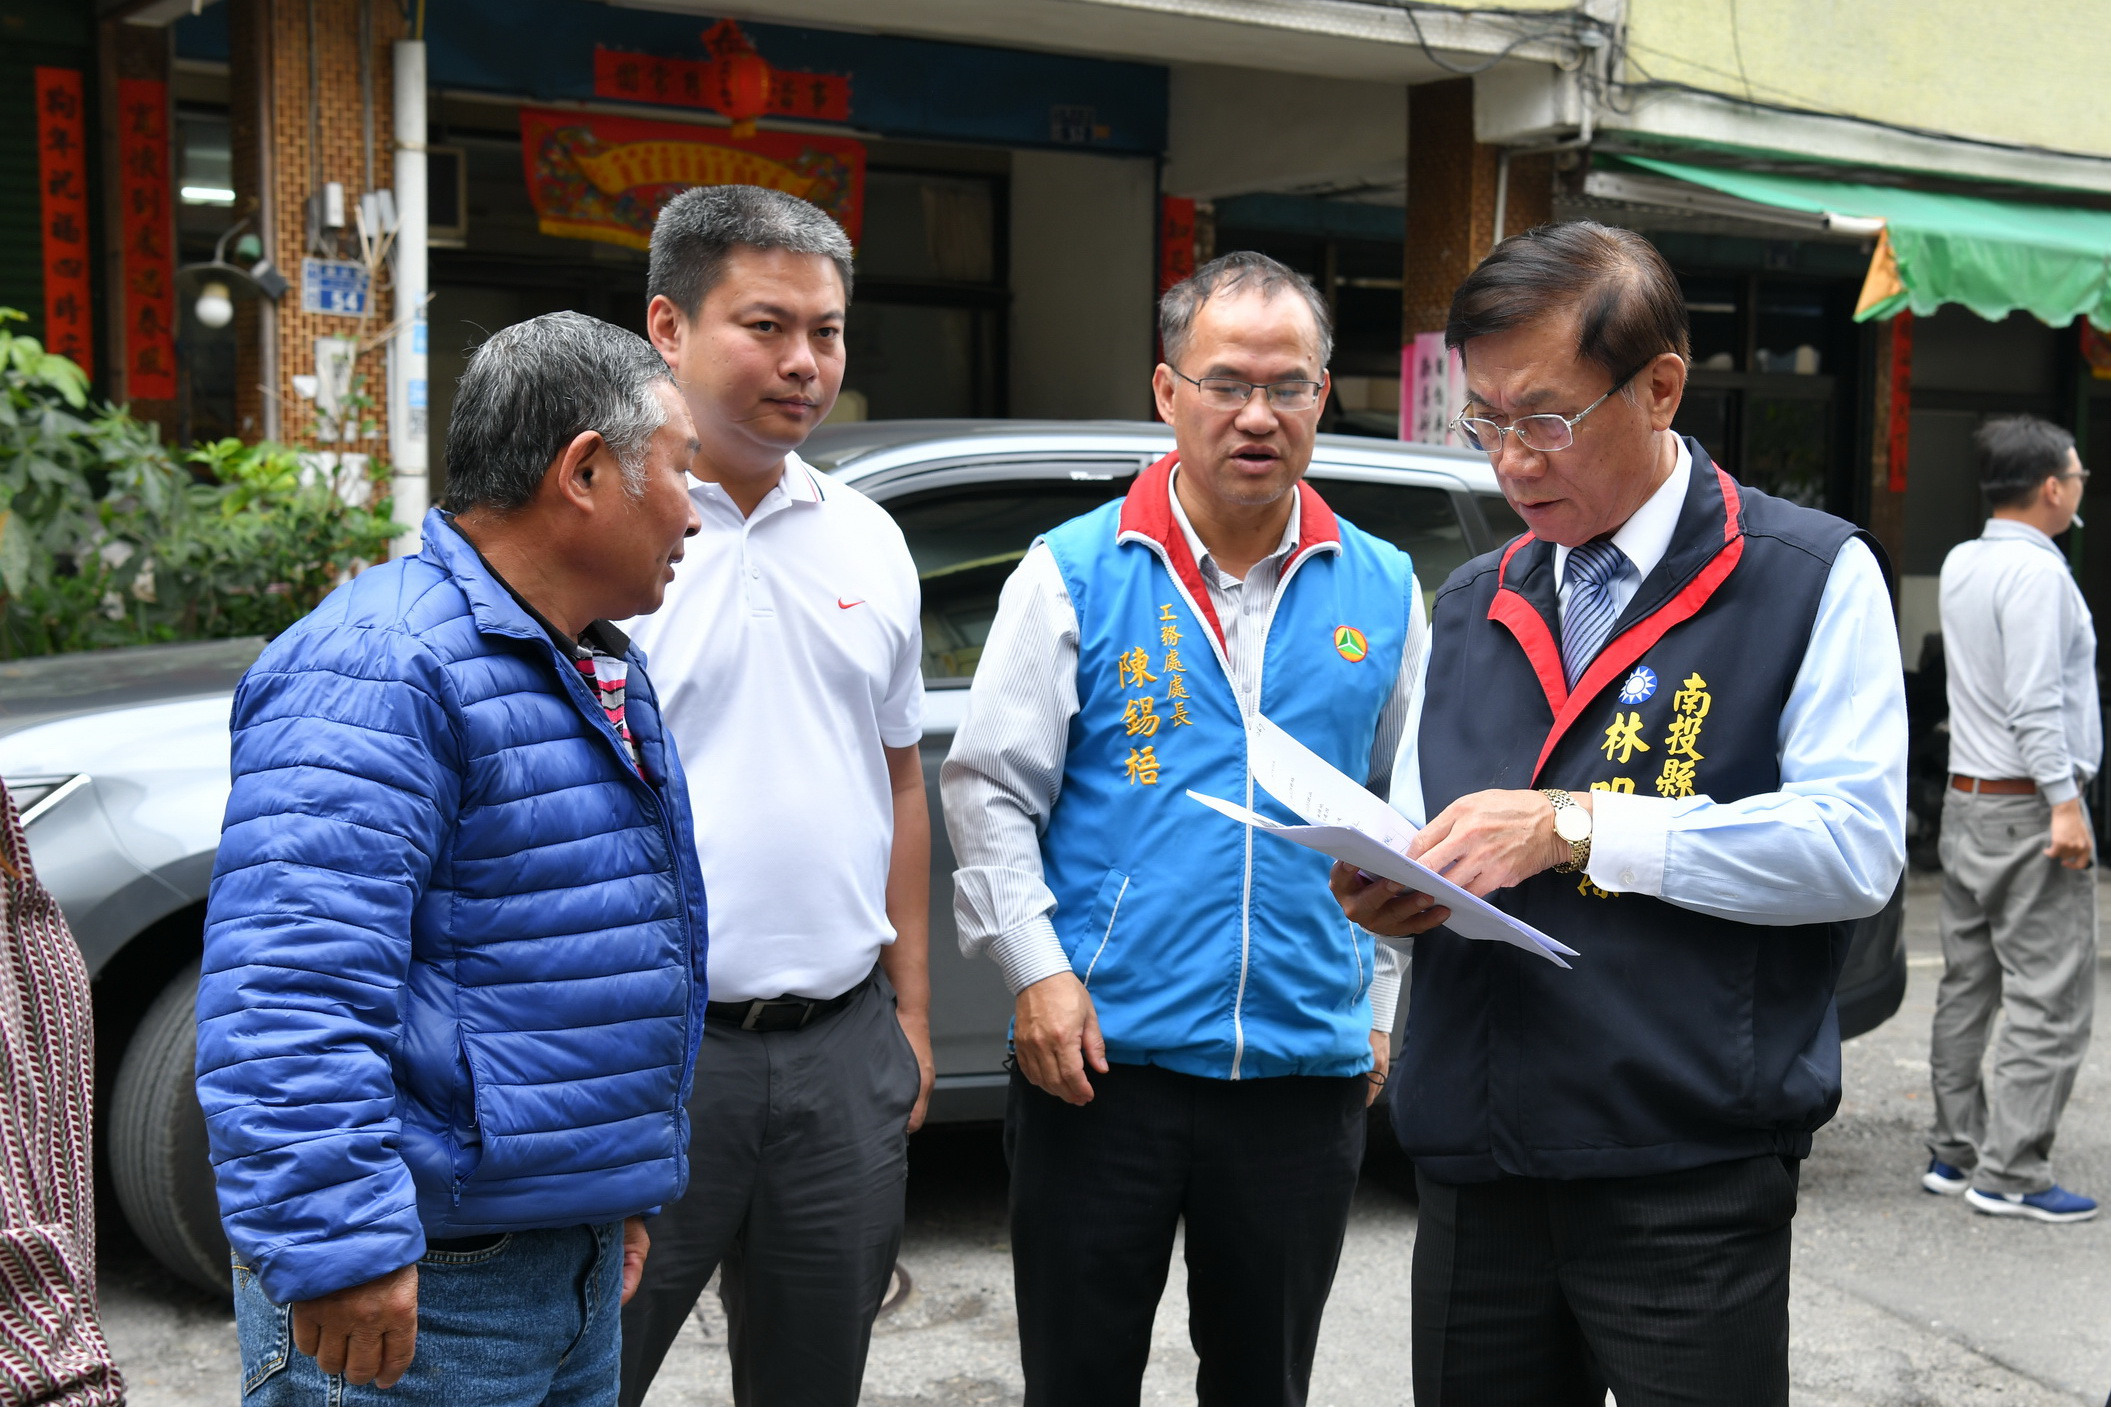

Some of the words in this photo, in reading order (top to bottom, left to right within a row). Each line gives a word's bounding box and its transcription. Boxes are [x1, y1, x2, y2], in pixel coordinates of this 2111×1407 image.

[1117, 646, 1161, 786] 陳錫梧
[1159, 603, 1194, 728] 工務處處長
